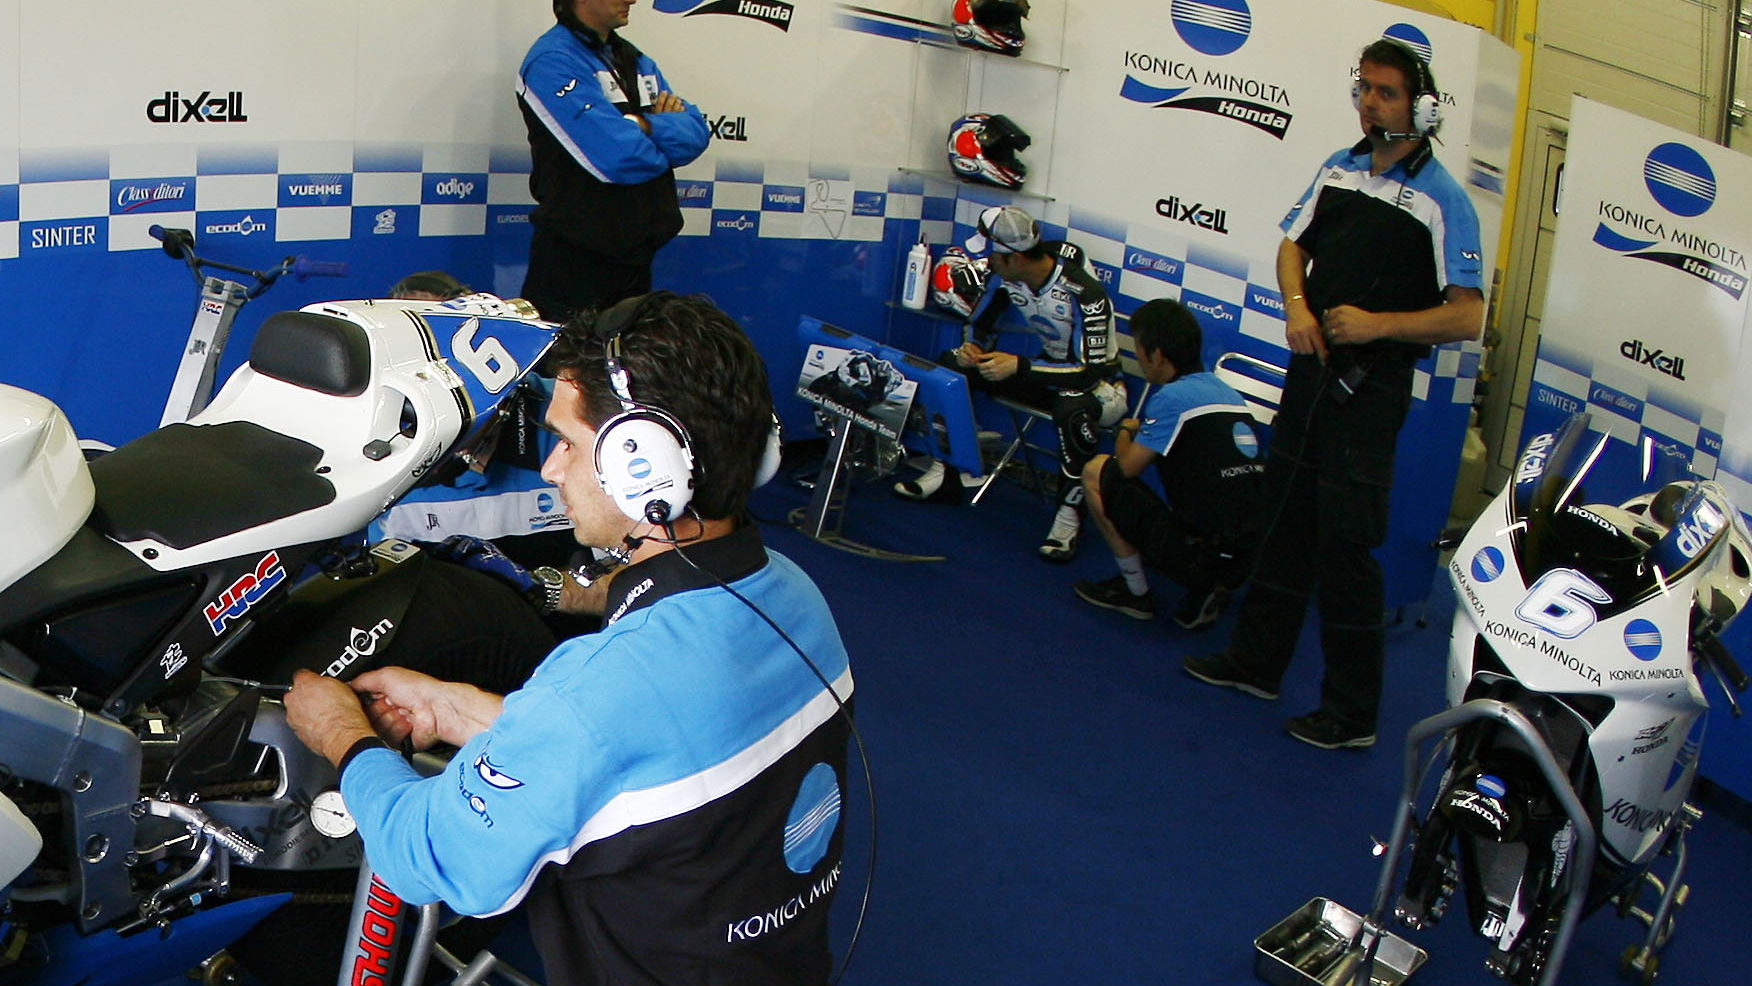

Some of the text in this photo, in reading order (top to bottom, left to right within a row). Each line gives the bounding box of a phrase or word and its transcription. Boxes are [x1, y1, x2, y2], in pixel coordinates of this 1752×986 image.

[737, 0, 791, 21] Honda
[1124, 51, 1290, 107] KONICA MINOLTA
[146, 91, 248, 123] dixell
[1217, 100, 1288, 130] Honda
[702, 113, 747, 142] ixell
[288, 183, 343, 197] VUEMME
[435, 180, 475, 199] adige
[1155, 195, 1229, 235] dixell
[31, 225, 96, 249] SINTER
[1599, 200, 1747, 271] KONICA MINOLTA
[1682, 258, 1744, 291] Honda
[1253, 293, 1285, 311] VUEM
[451, 315, 521, 395] 6
[1619, 338, 1686, 382] dixell
[1537, 388, 1579, 414] SINTER
[1566, 504, 1619, 537] HONDA
[202, 551, 288, 637] HRC
[1513, 566, 1614, 641] 6
[1484, 620, 1602, 688] KONICA MINOLTA
[1608, 667, 1685, 682] KONICA MINOLTA
[1631, 735, 1670, 757] HONDA
[1450, 798, 1503, 833] HONDA
[727, 893, 806, 943] KONICA
